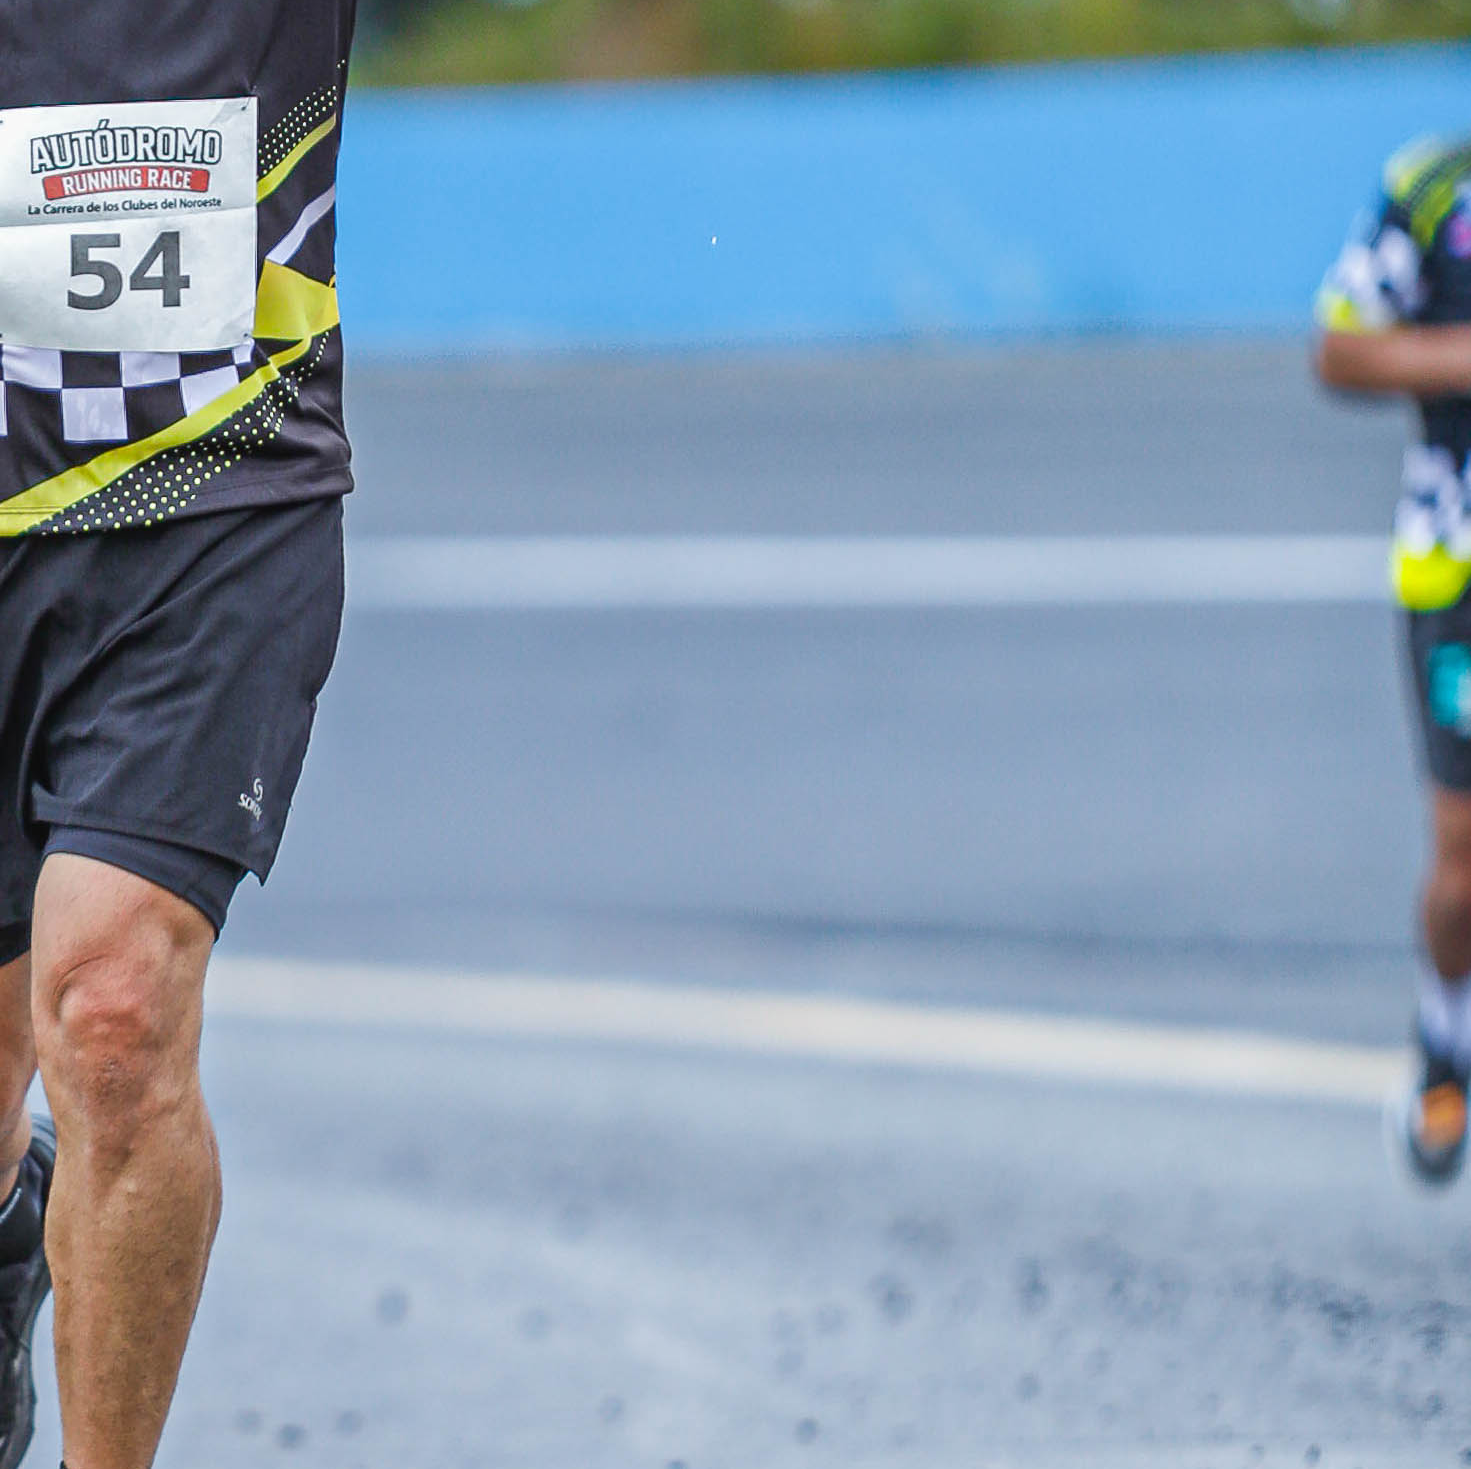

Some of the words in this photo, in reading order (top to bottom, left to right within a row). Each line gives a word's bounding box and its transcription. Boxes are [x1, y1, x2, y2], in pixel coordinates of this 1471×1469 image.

[31, 119, 222, 174] AUTÓDROMO
[61, 169, 142, 196] RUNNING
[147, 168, 192, 189] RACE
[28, 204, 41, 215] La
[43, 203, 84, 214] Carrera
[86, 201, 101, 213] de
[103, 201, 119, 212] los
[121, 199, 158, 211] Clubes
[160, 198, 177, 210] del
[179, 197, 222, 209] Noroeste
[67, 231, 191, 310] 54
